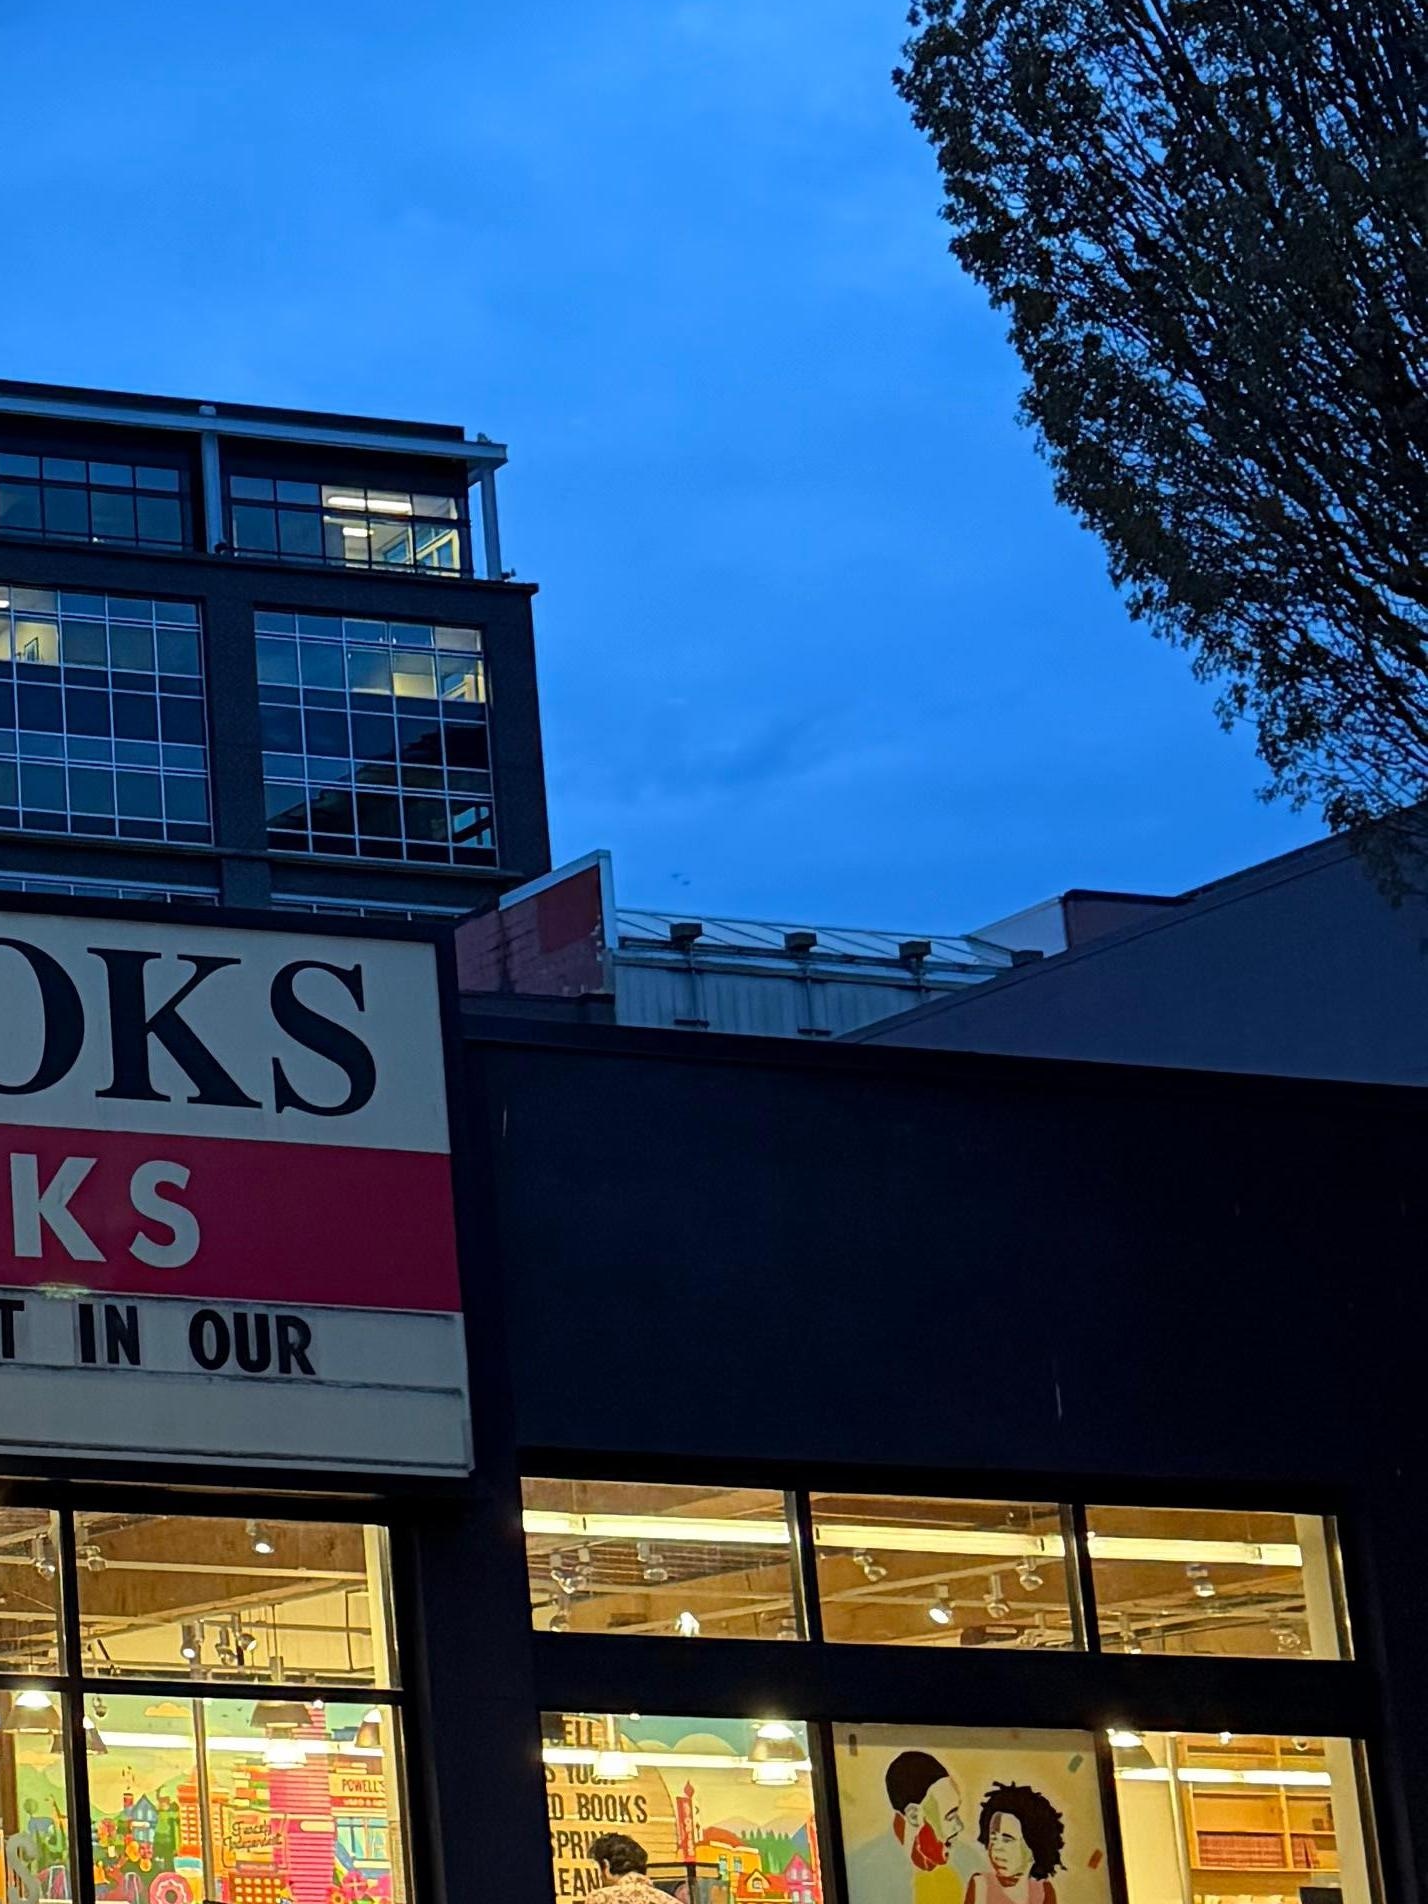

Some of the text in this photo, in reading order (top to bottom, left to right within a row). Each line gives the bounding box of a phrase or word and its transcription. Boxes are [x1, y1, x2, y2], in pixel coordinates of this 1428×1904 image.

[79, 1303, 141, 1367] IN
[189, 1308, 318, 1377] OUR
[576, 1793, 648, 1824] BOOKS
